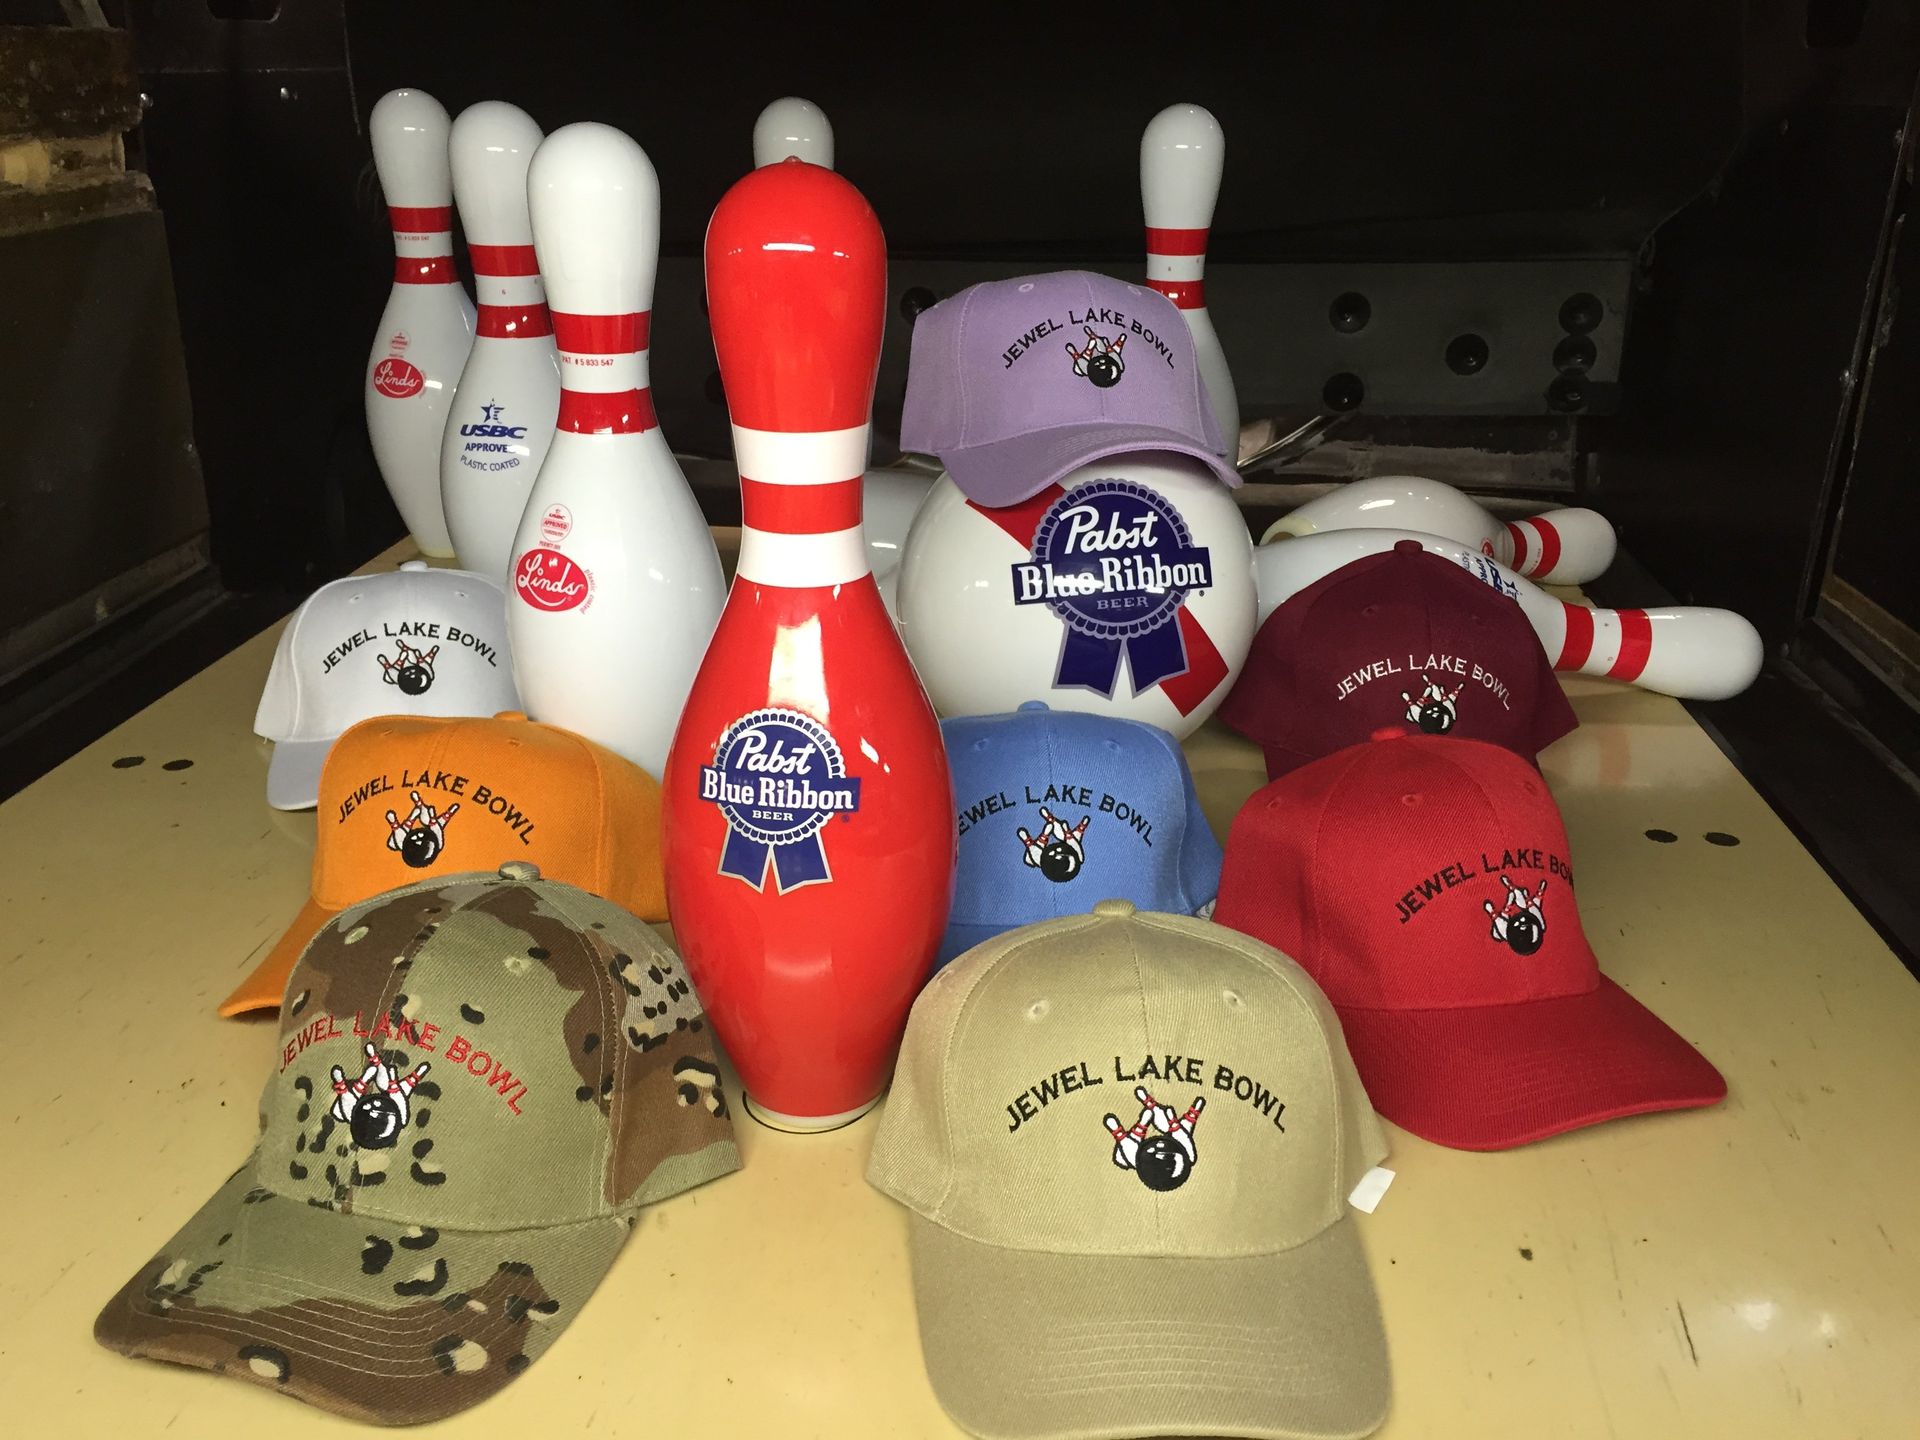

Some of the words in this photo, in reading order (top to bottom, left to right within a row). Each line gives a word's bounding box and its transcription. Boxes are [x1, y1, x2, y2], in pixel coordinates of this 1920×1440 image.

[600, 359, 614, 367] 547
[1001, 318, 1063, 370] JEWEL
[1068, 308, 1126, 328] LAKE
[1130, 319, 1176, 369] BOWL
[375, 361, 420, 395] Linds
[460, 424, 528, 439] USBC
[460, 454, 488, 472] PLASTIC
[489, 457, 520, 472] COATED
[1058, 505, 1159, 555] Pabst
[518, 553, 586, 607] Linds
[1017, 563, 1098, 601] Blue
[1099, 553, 1208, 595] Ribbon
[1097, 596, 1149, 611] BEER
[322, 628, 378, 674] JEWEL
[383, 622, 441, 639] LAKE
[446, 626, 498, 668] BOWL
[1336, 658, 1402, 701] JEWEL
[1408, 653, 1468, 676] LAKE
[1471, 663, 1511, 711] BOWL
[735, 729, 817, 776] Pabst
[339, 774, 394, 824] JEWEL
[401, 769, 470, 797] LAKE
[471, 785, 535, 846] BOWL
[702, 768, 755, 805] Blue
[757, 776, 854, 810] Ribbon
[752, 809, 794, 822] BEER
[958, 791, 1017, 837] EWEL
[1024, 783, 1093, 808] LAKE
[1097, 793, 1153, 848] BOWL
[1394, 862, 1476, 925] JEWEL
[1481, 848, 1545, 873] LAKE
[1549, 854, 1574, 890] BO
[279, 1014, 343, 1074] JEWEL
[352, 1010, 442, 1053] LAKE
[444, 1034, 528, 1117] BOWL
[1005, 1061, 1104, 1134] JEWEL
[1114, 1054, 1204, 1086] LAKE
[1213, 1064, 1287, 1134] BOWL
